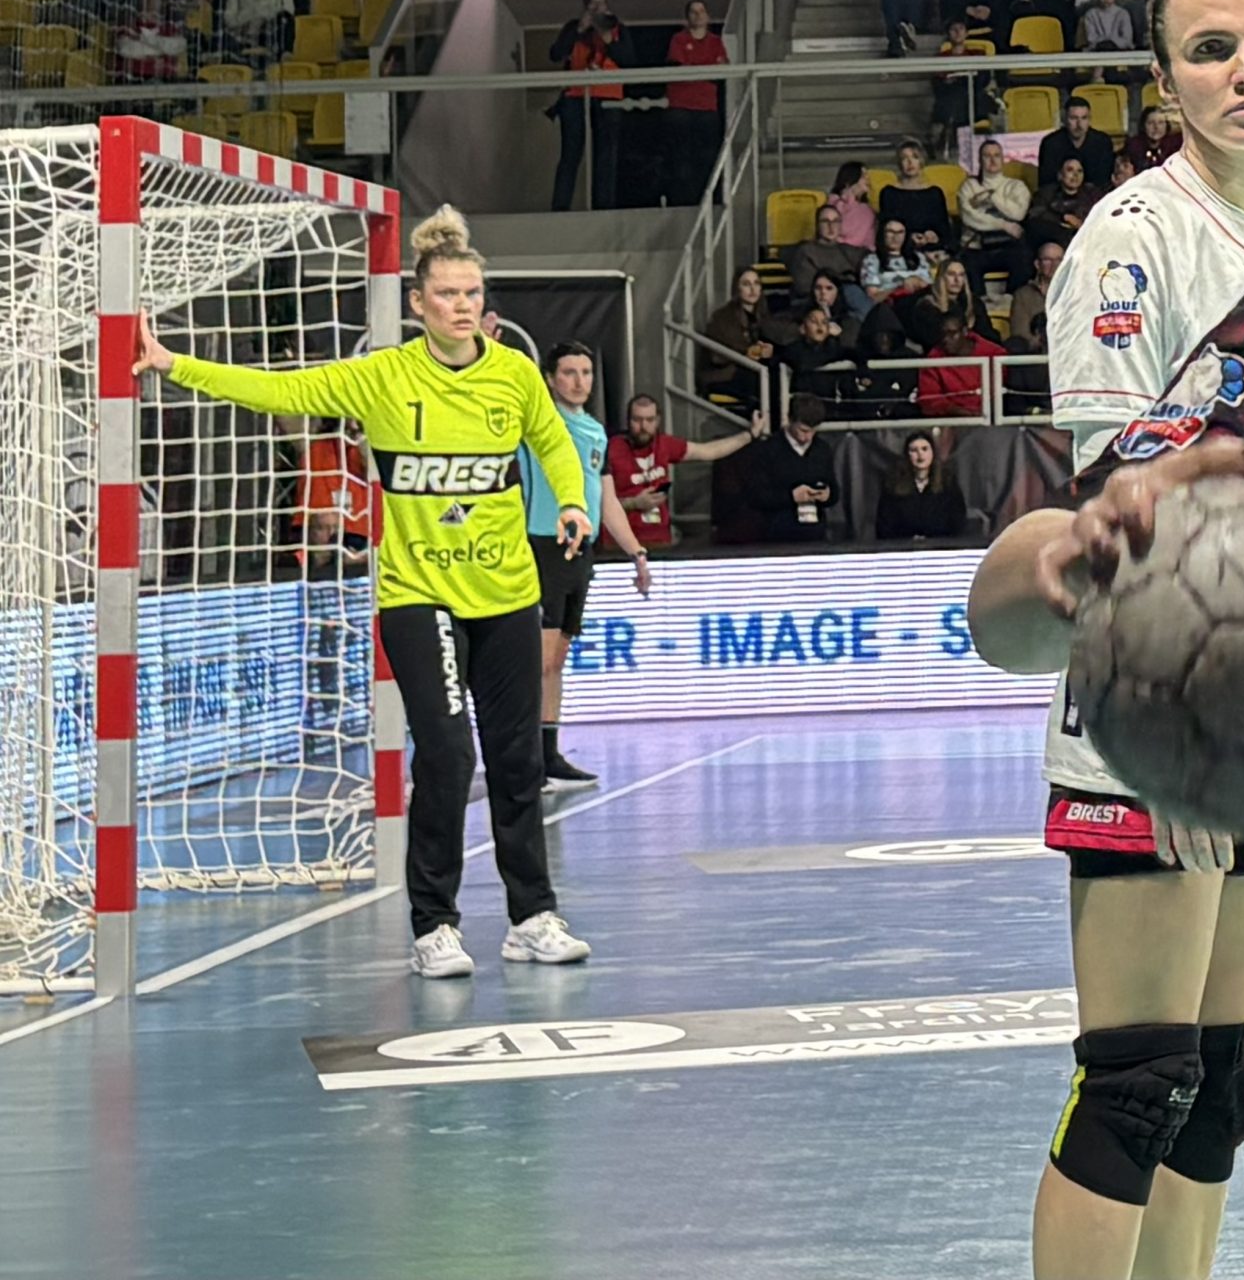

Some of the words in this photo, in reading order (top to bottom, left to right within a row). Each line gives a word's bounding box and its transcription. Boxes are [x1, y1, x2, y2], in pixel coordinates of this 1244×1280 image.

[407, 400, 423, 441] 1
[391, 454, 515, 493] BREST
[700, 607, 880, 664] IMAGE
[1066, 802, 1130, 825] BREST
